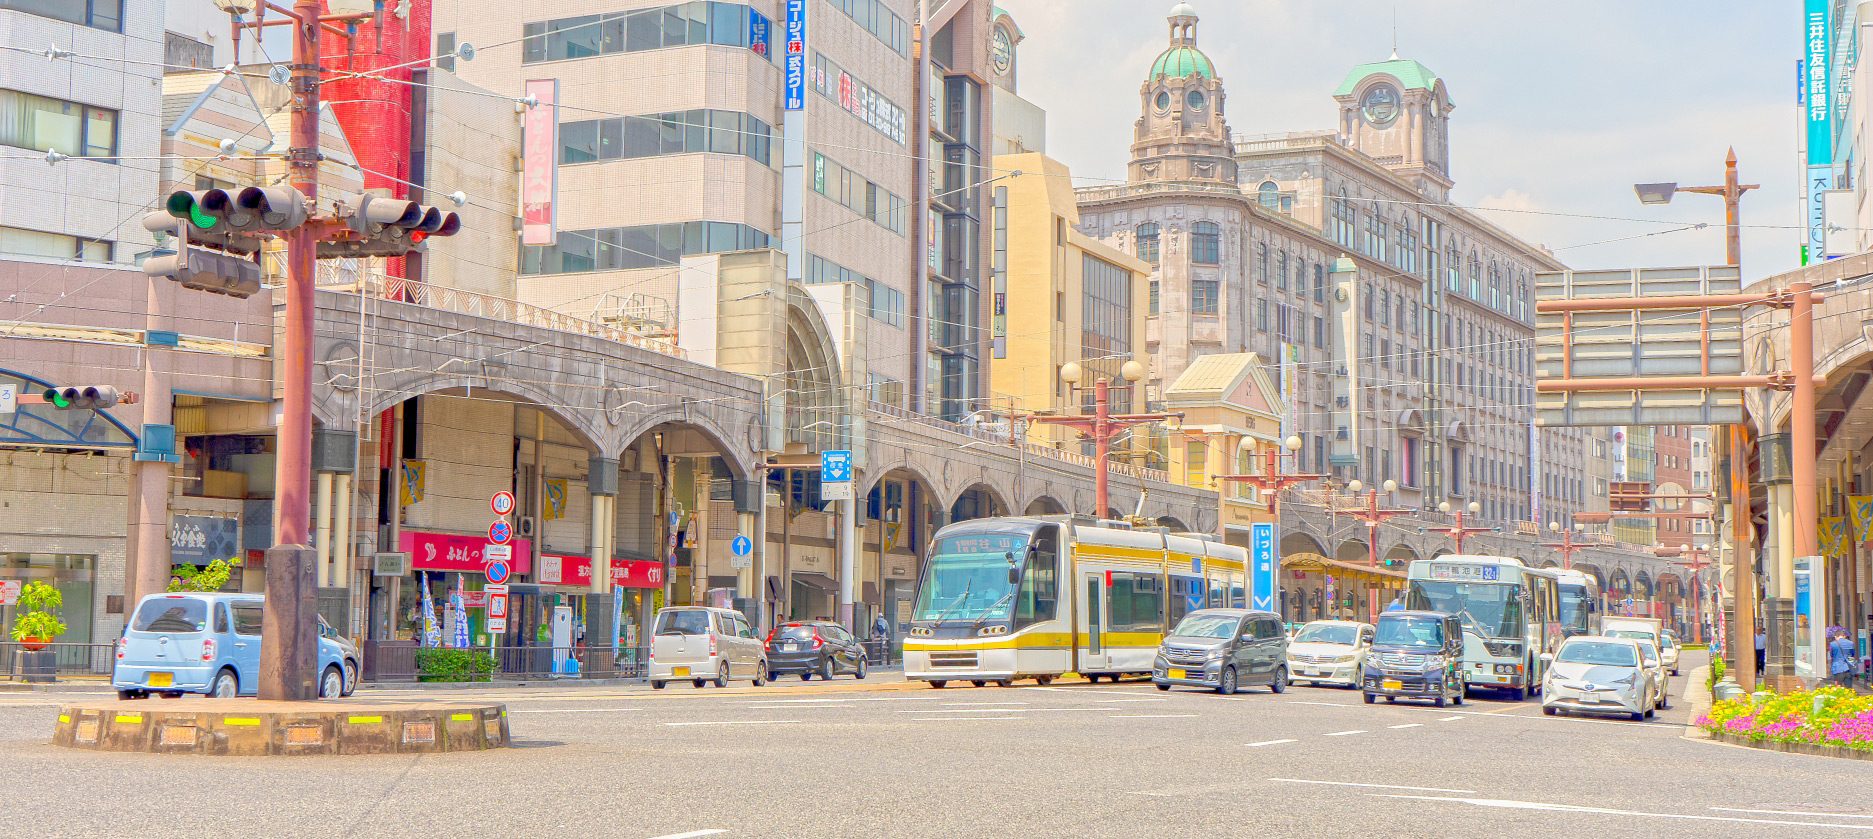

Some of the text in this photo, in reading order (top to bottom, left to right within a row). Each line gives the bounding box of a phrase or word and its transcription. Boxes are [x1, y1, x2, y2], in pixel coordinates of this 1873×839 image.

[788, 1, 803, 109] コージュ株式スクール
[1809, 12, 1827, 121] 三井住友信託銀行
[496, 498, 509, 509] 40
[647, 567, 661, 583] くすり
